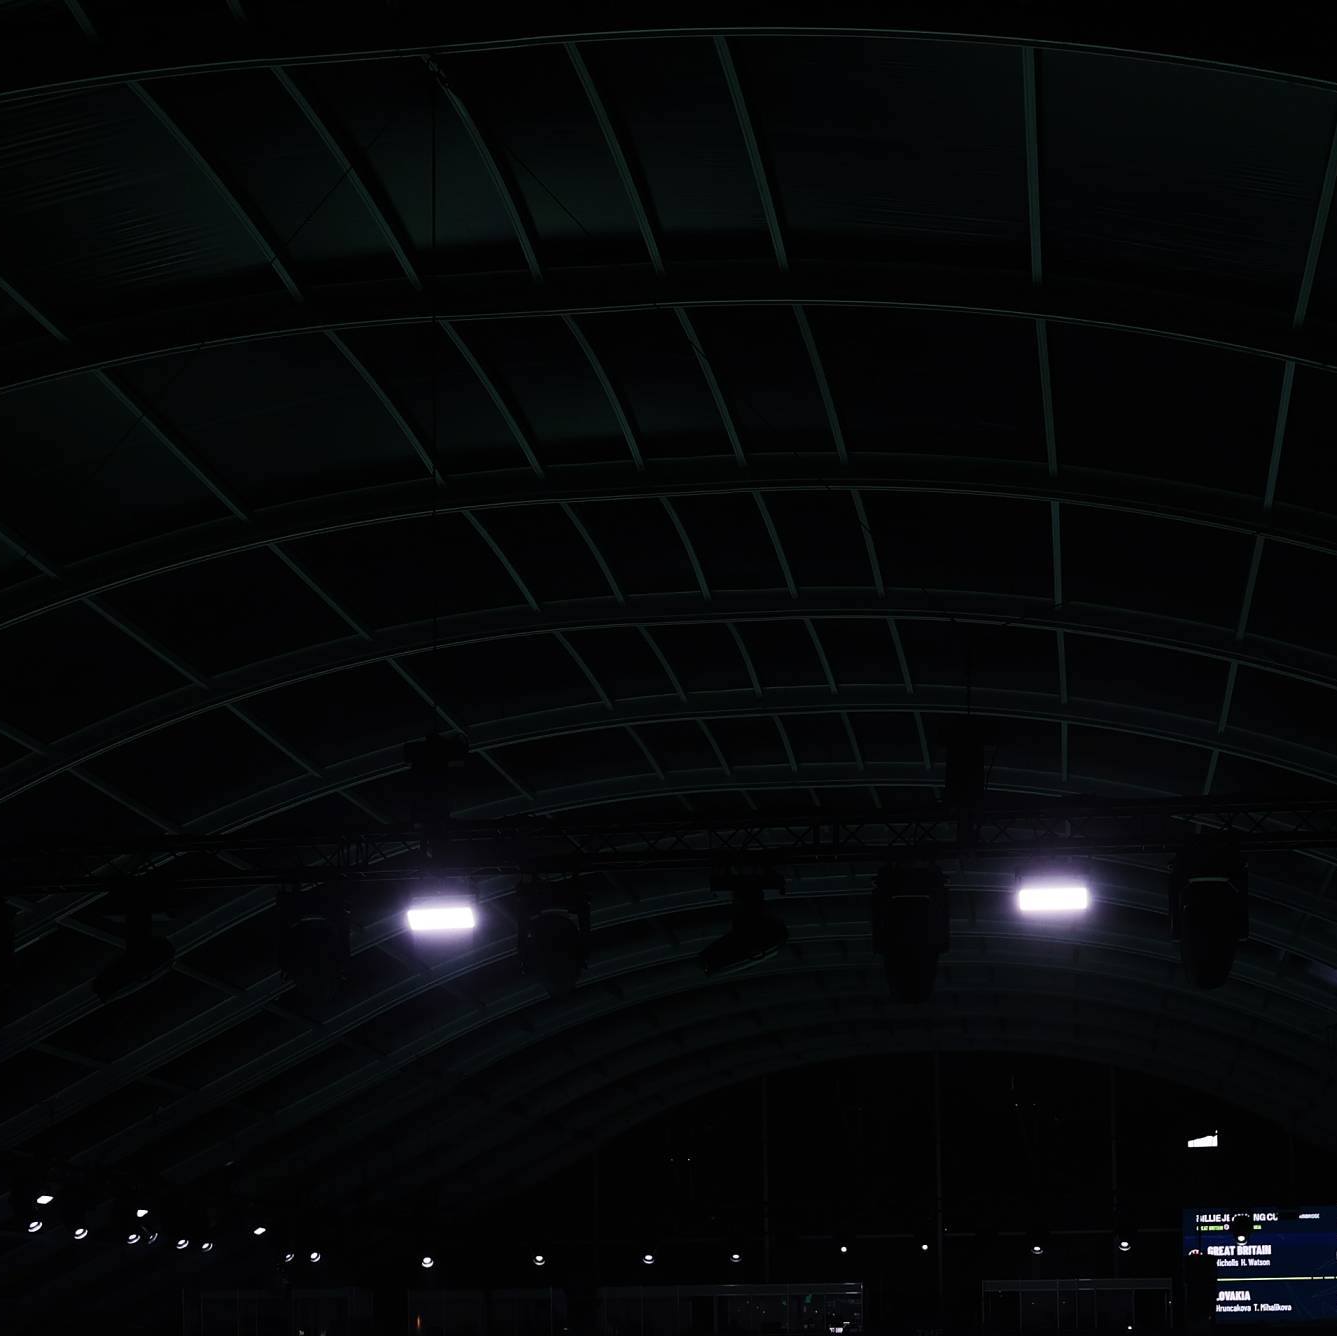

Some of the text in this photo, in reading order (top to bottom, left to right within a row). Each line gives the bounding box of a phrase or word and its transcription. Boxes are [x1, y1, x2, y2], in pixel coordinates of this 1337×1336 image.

[1207, 1246, 1235, 1256] GREAT
[1237, 1245, 1271, 1255] BRITAIN
[1254, 1303, 1260, 1312] T.
